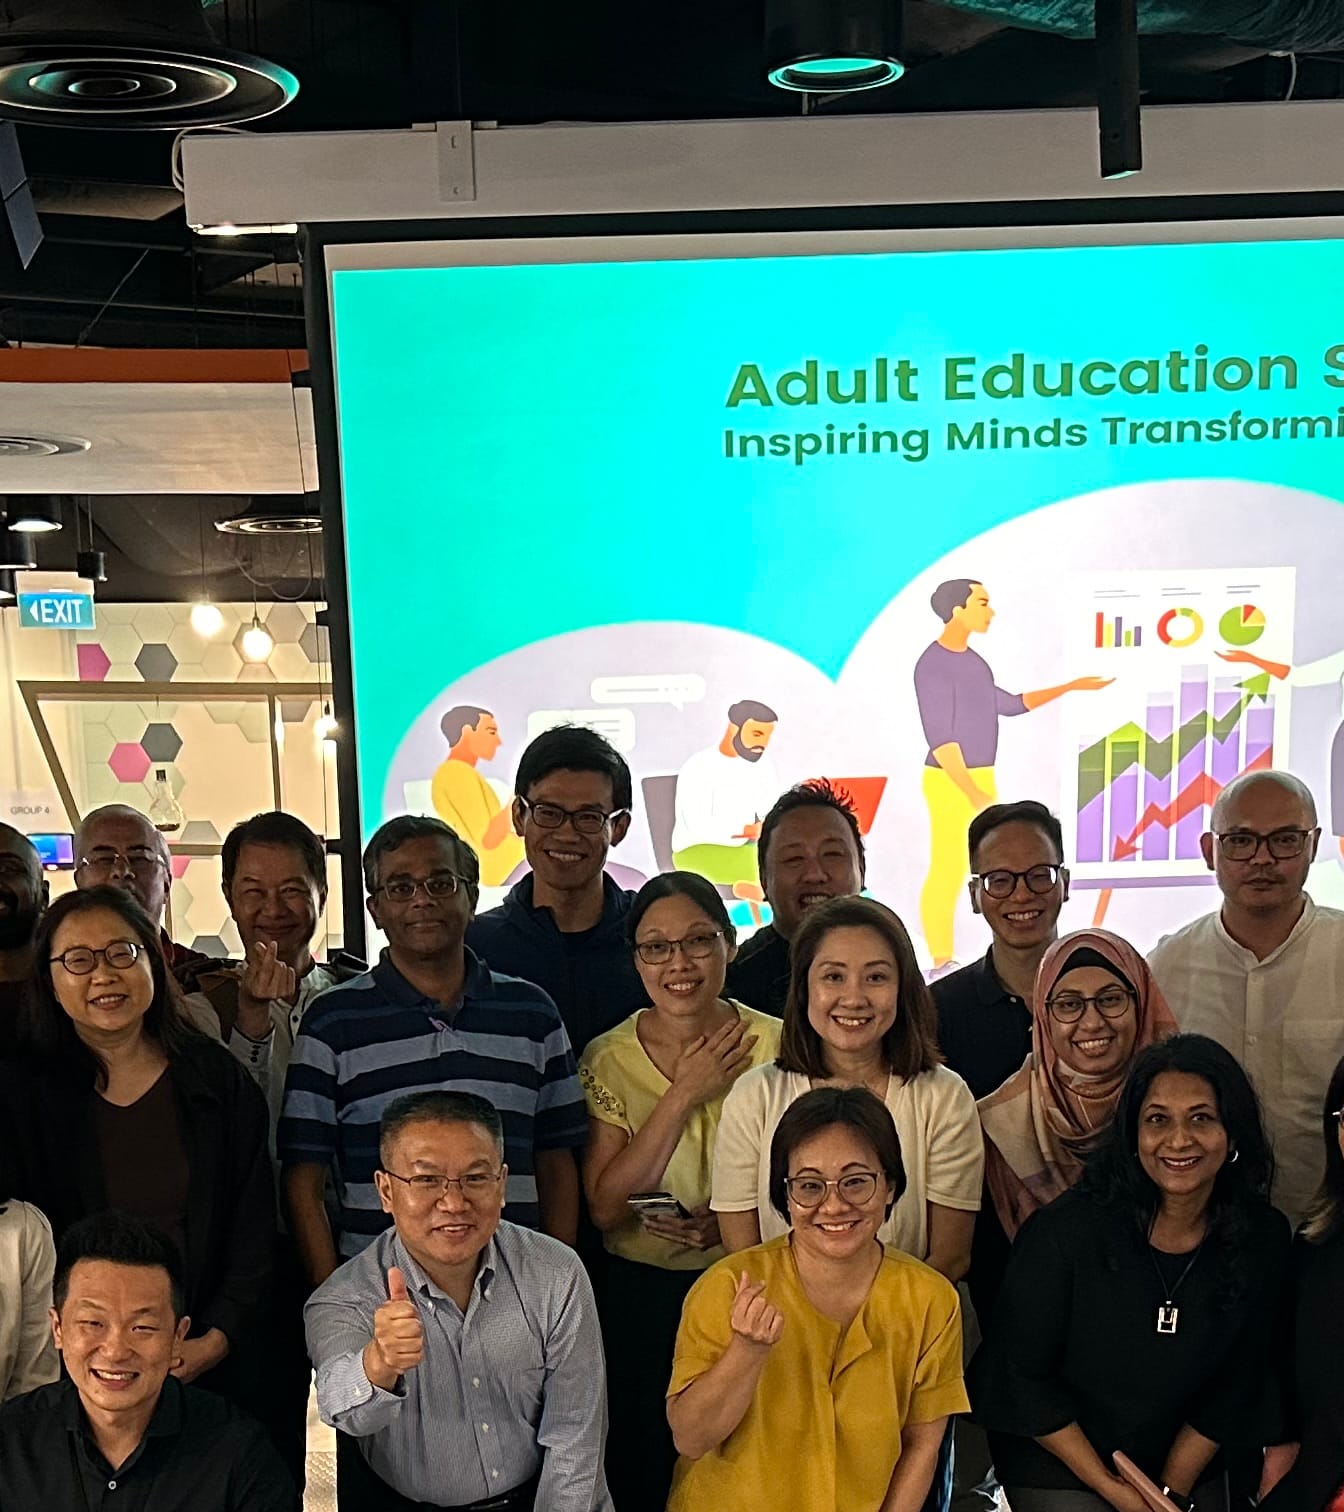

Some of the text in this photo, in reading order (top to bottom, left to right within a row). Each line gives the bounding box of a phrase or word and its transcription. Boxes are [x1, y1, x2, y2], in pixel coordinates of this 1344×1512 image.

[725, 357, 919, 408] Adult
[944, 343, 1298, 401] Education
[725, 423, 929, 466] Inspiring
[946, 417, 1088, 451] Minds
[39, 598, 84, 624] EXIT
[10, 806, 43, 815] GROUP
